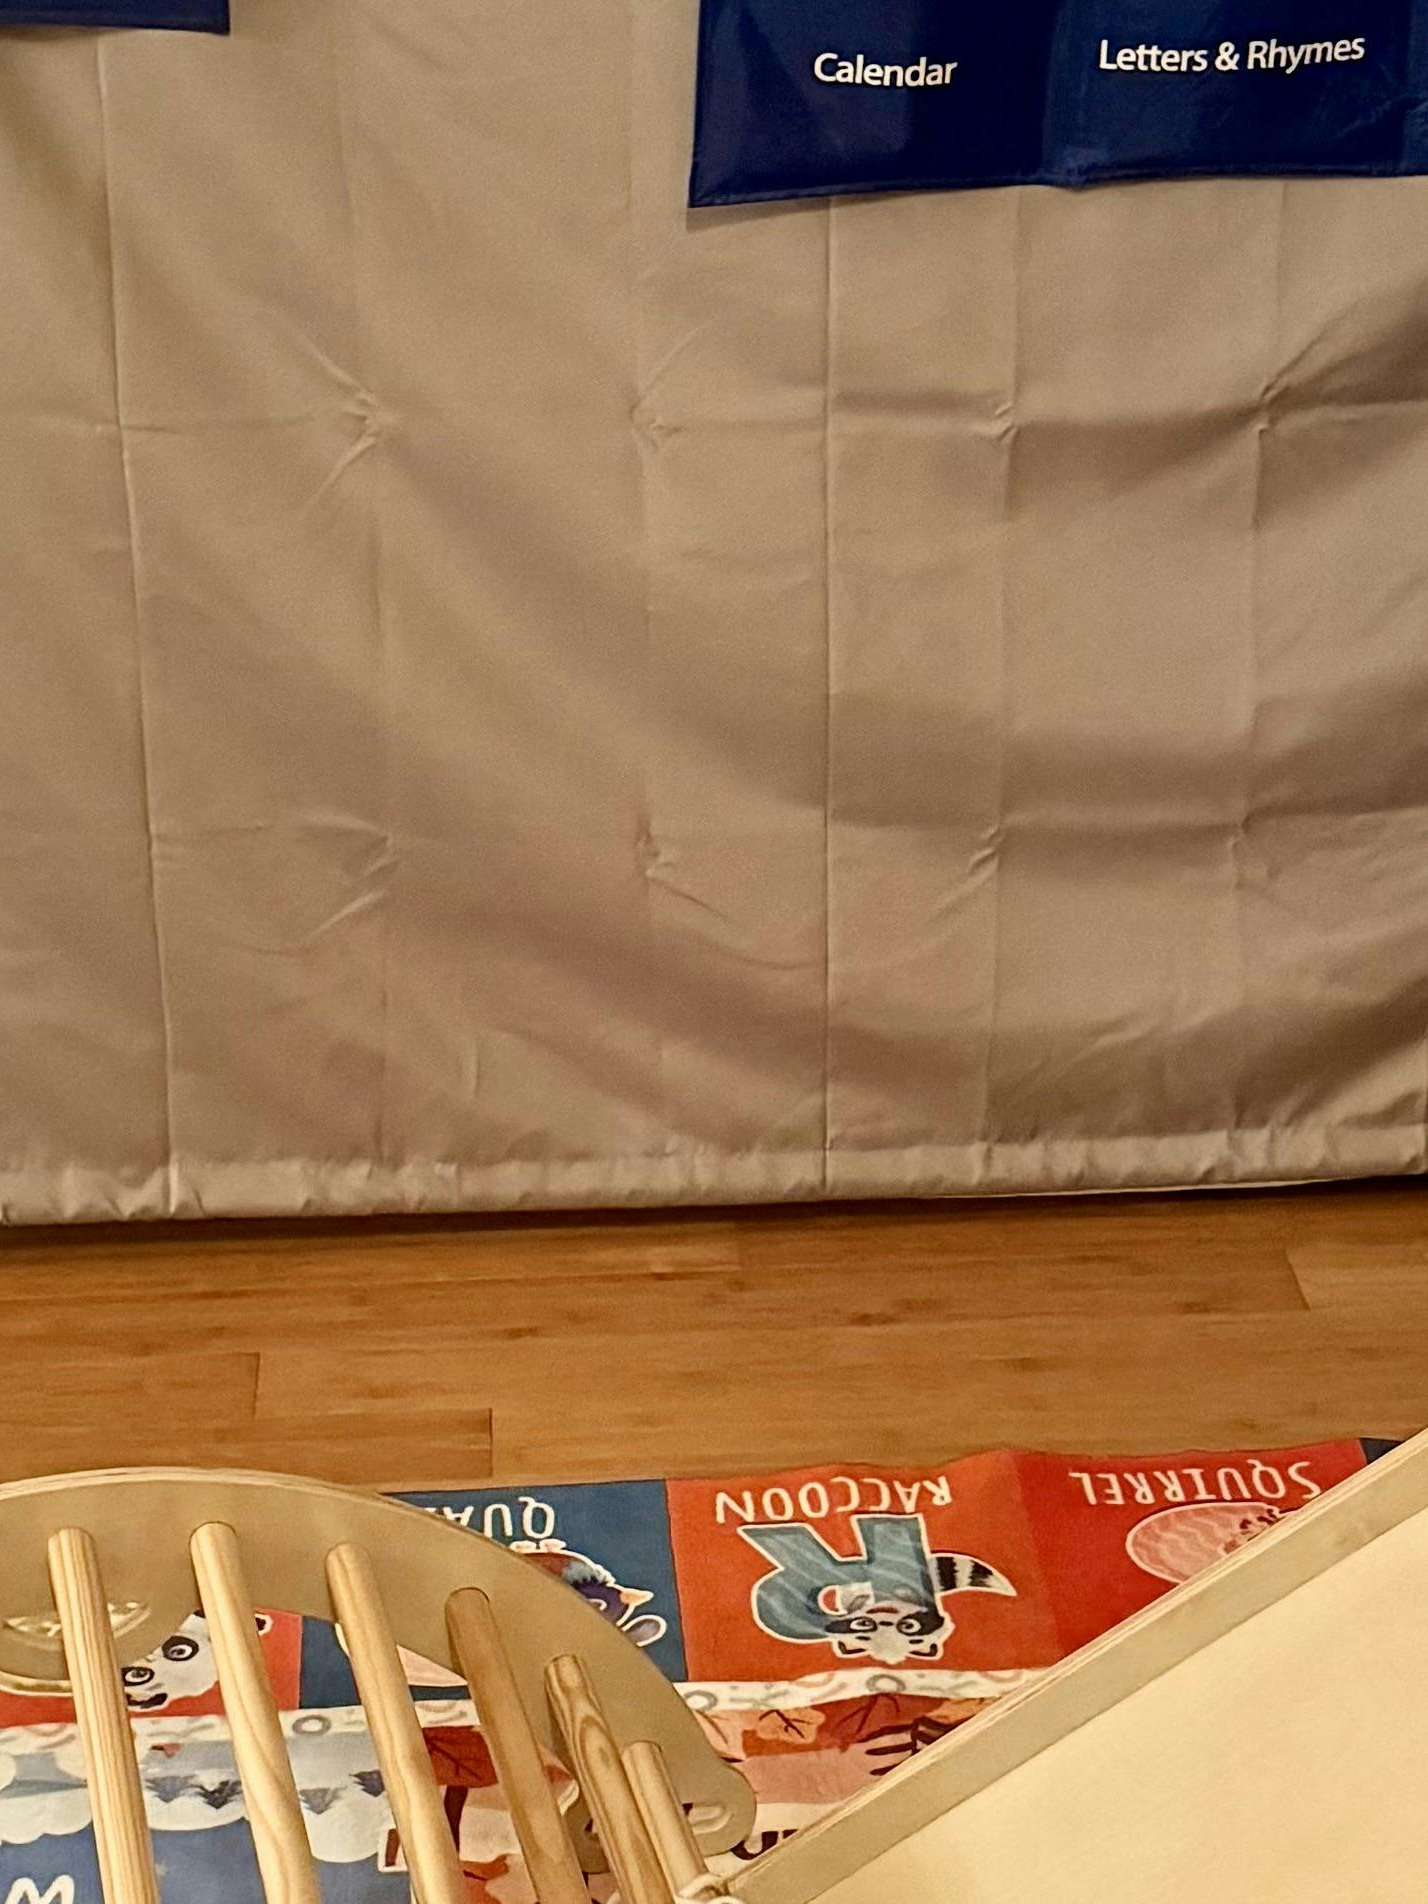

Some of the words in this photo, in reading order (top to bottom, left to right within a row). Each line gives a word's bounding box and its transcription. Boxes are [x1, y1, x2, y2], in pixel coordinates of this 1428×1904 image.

[812, 53, 958, 89] Calendar
[1098, 39, 1208, 74] Letters
[1214, 42, 1240, 71] &
[1246, 34, 1367, 77] Rhymes
[715, 1475, 953, 1524] RACCOON
[1068, 1458, 1322, 1506] SQUIRREL
[438, 1497, 555, 1539] QUA
